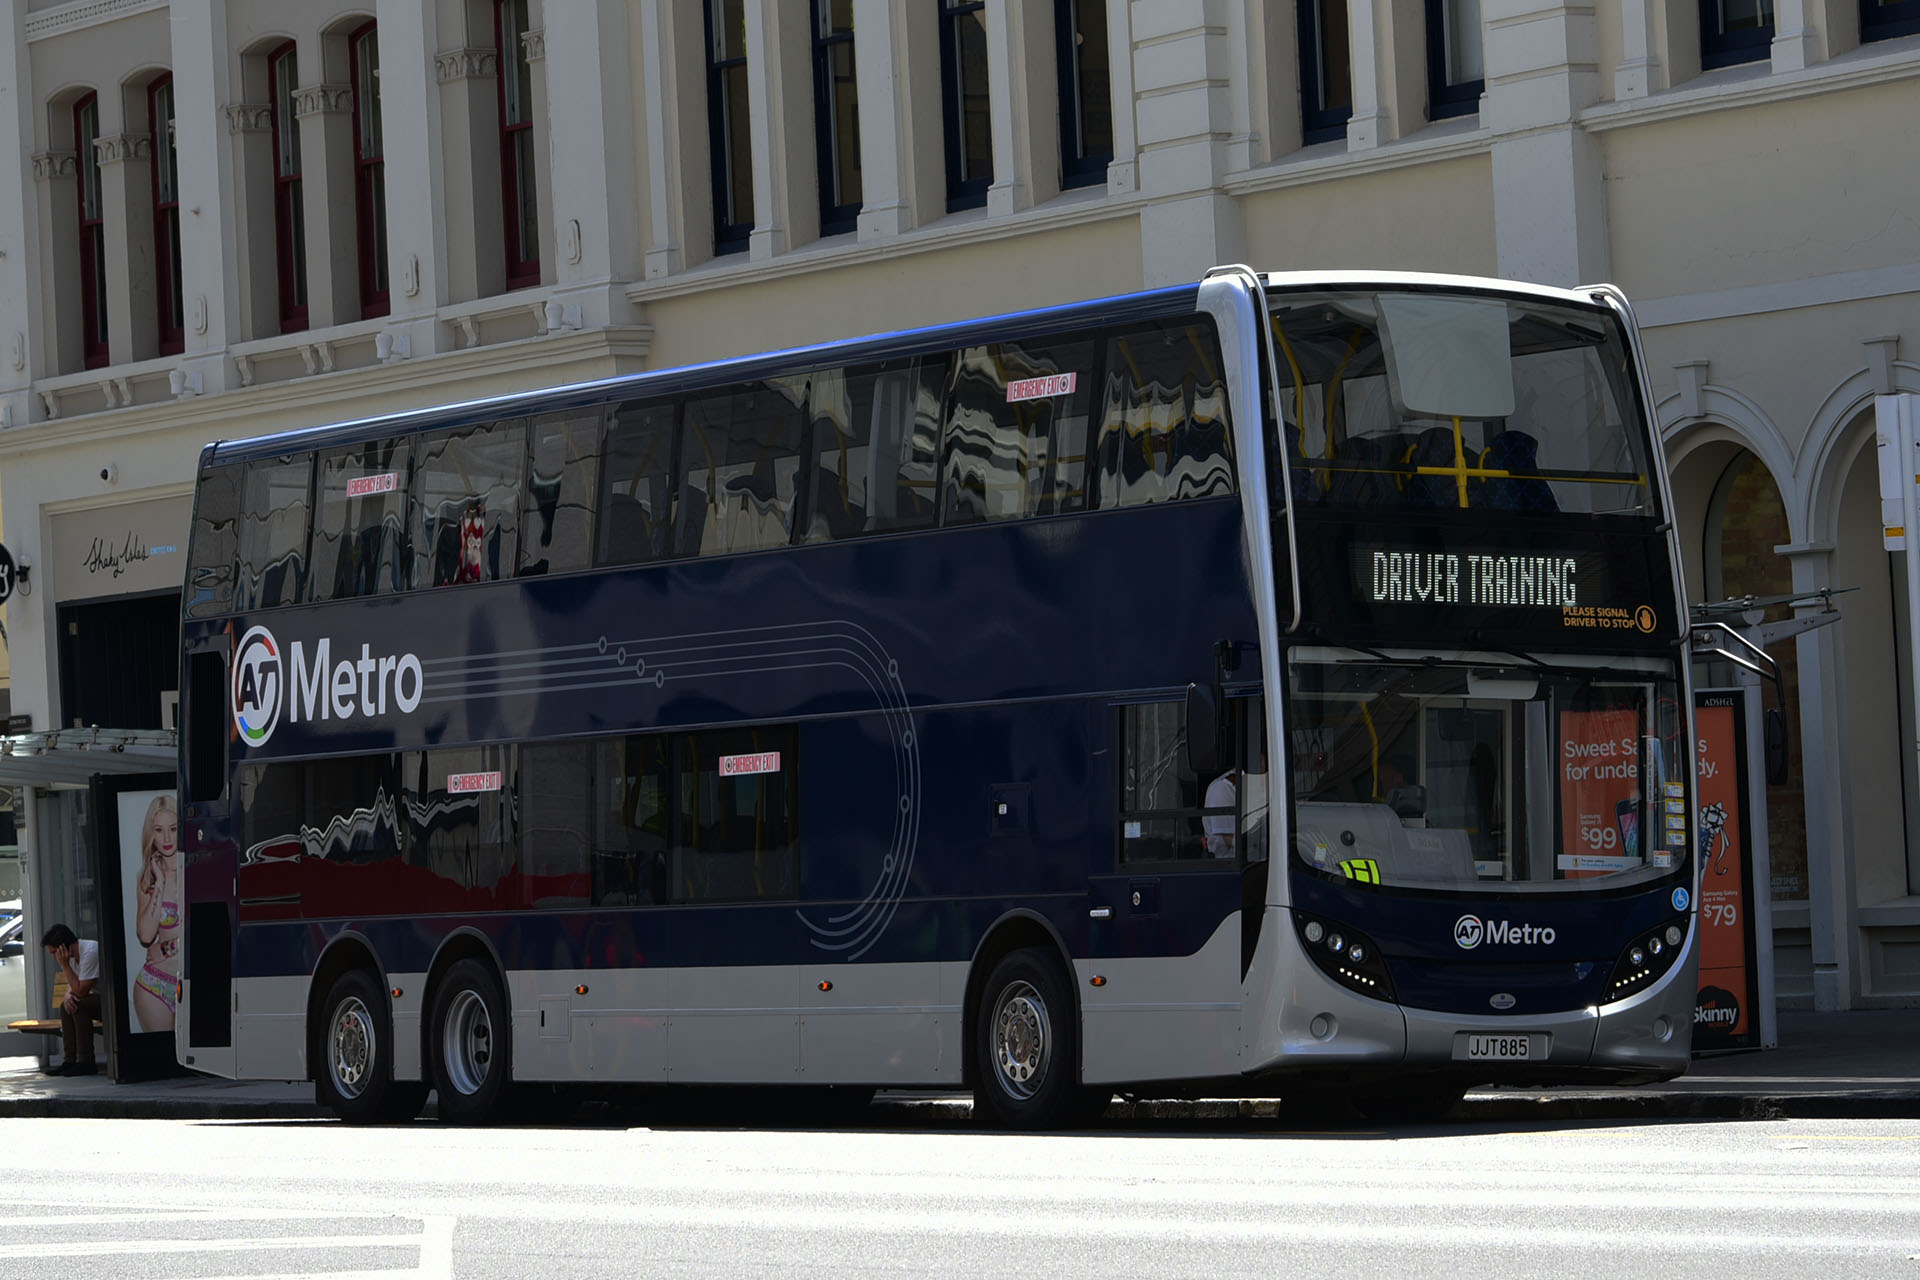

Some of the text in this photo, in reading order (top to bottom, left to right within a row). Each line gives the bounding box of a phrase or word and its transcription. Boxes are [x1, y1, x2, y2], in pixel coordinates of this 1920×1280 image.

[1014, 376, 1060, 400] EMERGENCY EXIT
[351, 475, 386, 495] EMERGENCY EXIT
[83, 537, 125, 578] Shaky
[1373, 552, 1576, 606] DRIVER TRAINING
[1563, 606, 1630, 618] PLEASE SIGNAL
[1564, 617, 1636, 629] DRIVER TO STOP
[290, 637, 423, 723] Metro
[1565, 740, 1616, 758] Sweet
[733, 753, 775, 773] EMERGENCY EXIT
[1565, 762, 1590, 780] for
[460, 773, 496, 791] EMERGENCY EXIT
[1581, 826, 1617, 850] $99
[1703, 903, 1737, 927] $79
[1486, 920, 1556, 945] Metro
[1470, 1039, 1527, 1056] JJT885
